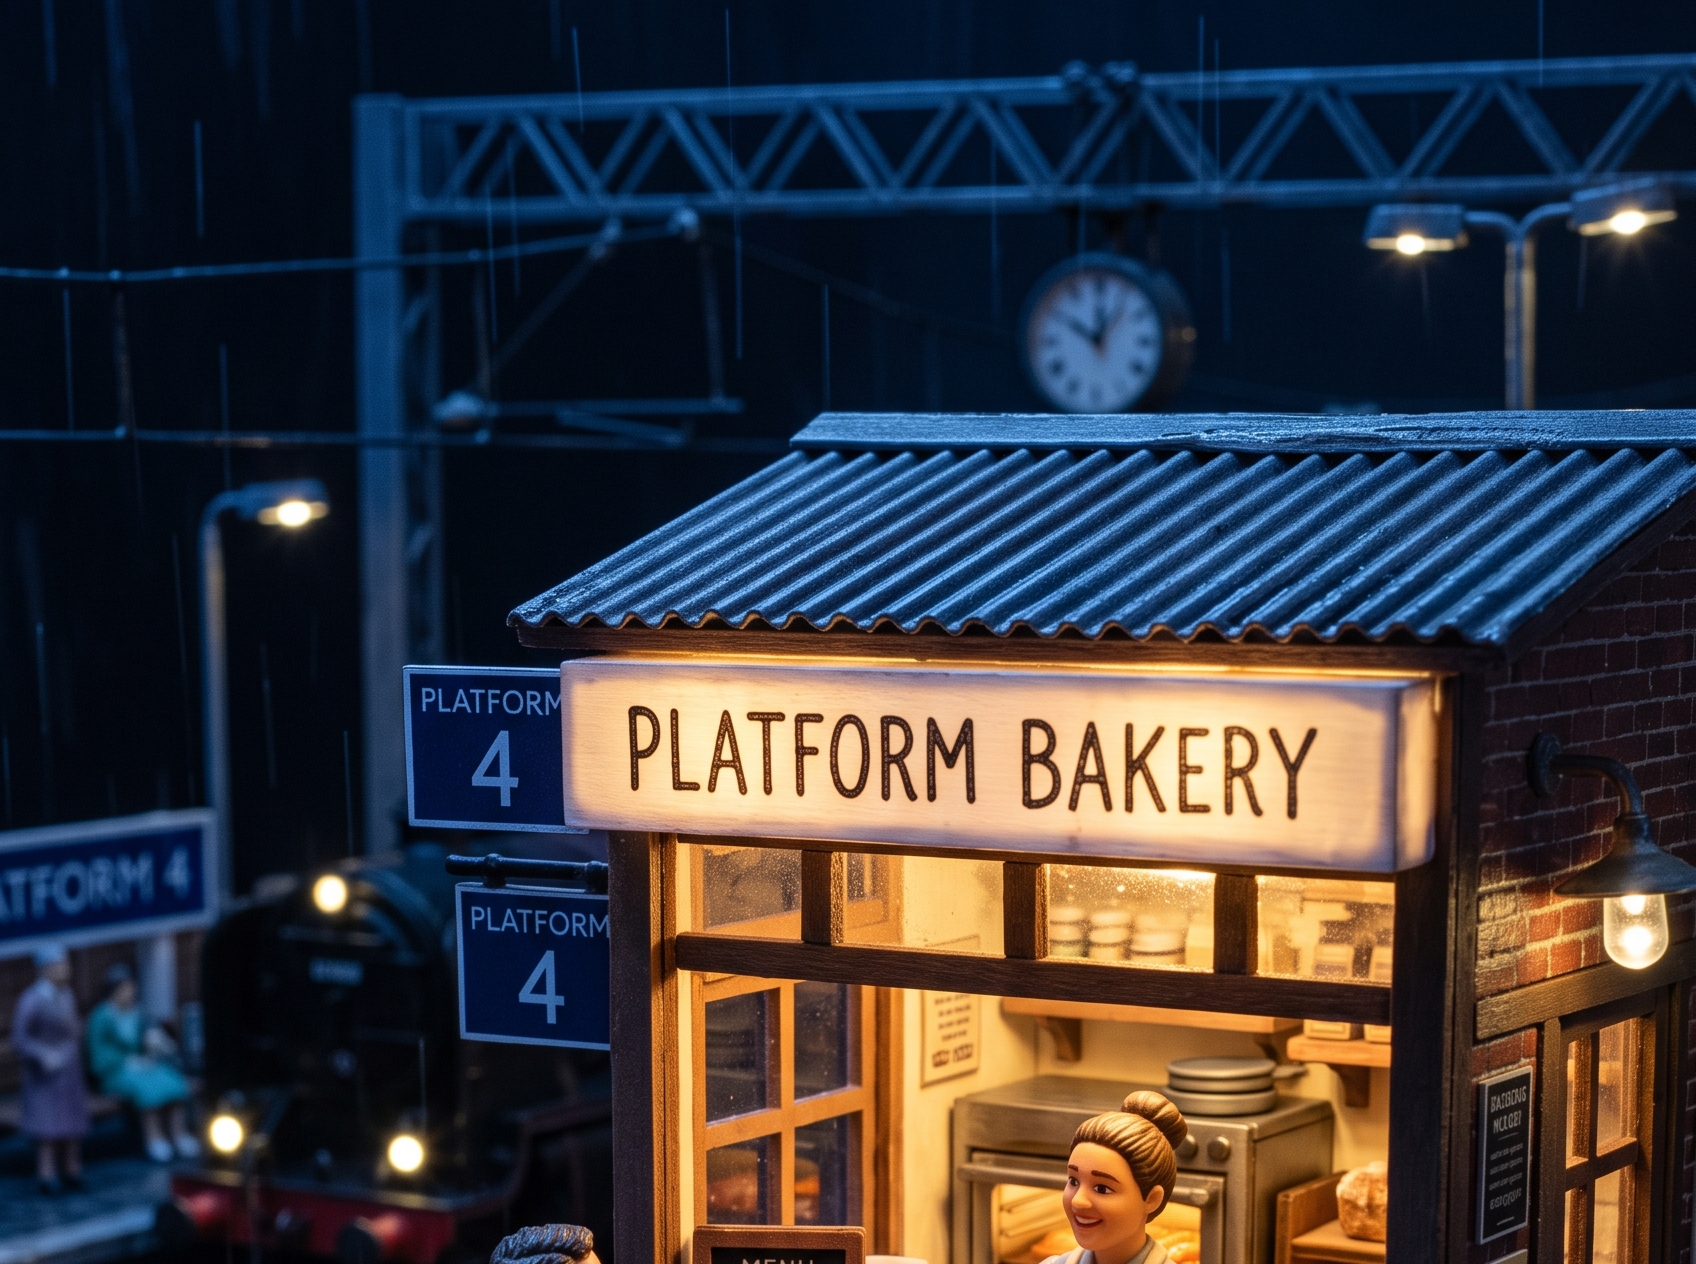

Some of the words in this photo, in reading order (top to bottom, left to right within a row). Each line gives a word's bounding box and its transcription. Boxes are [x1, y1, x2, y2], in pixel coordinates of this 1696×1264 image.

[421, 687, 561, 716] PLATFORM
[471, 730, 519, 807] 4
[628, 705, 976, 805] PLATFORM
[1021, 718, 1317, 820] BAKERY
[163, 843, 192, 899] 4
[471, 906, 609, 938] PLATFORM
[518, 949, 565, 1024] 4
